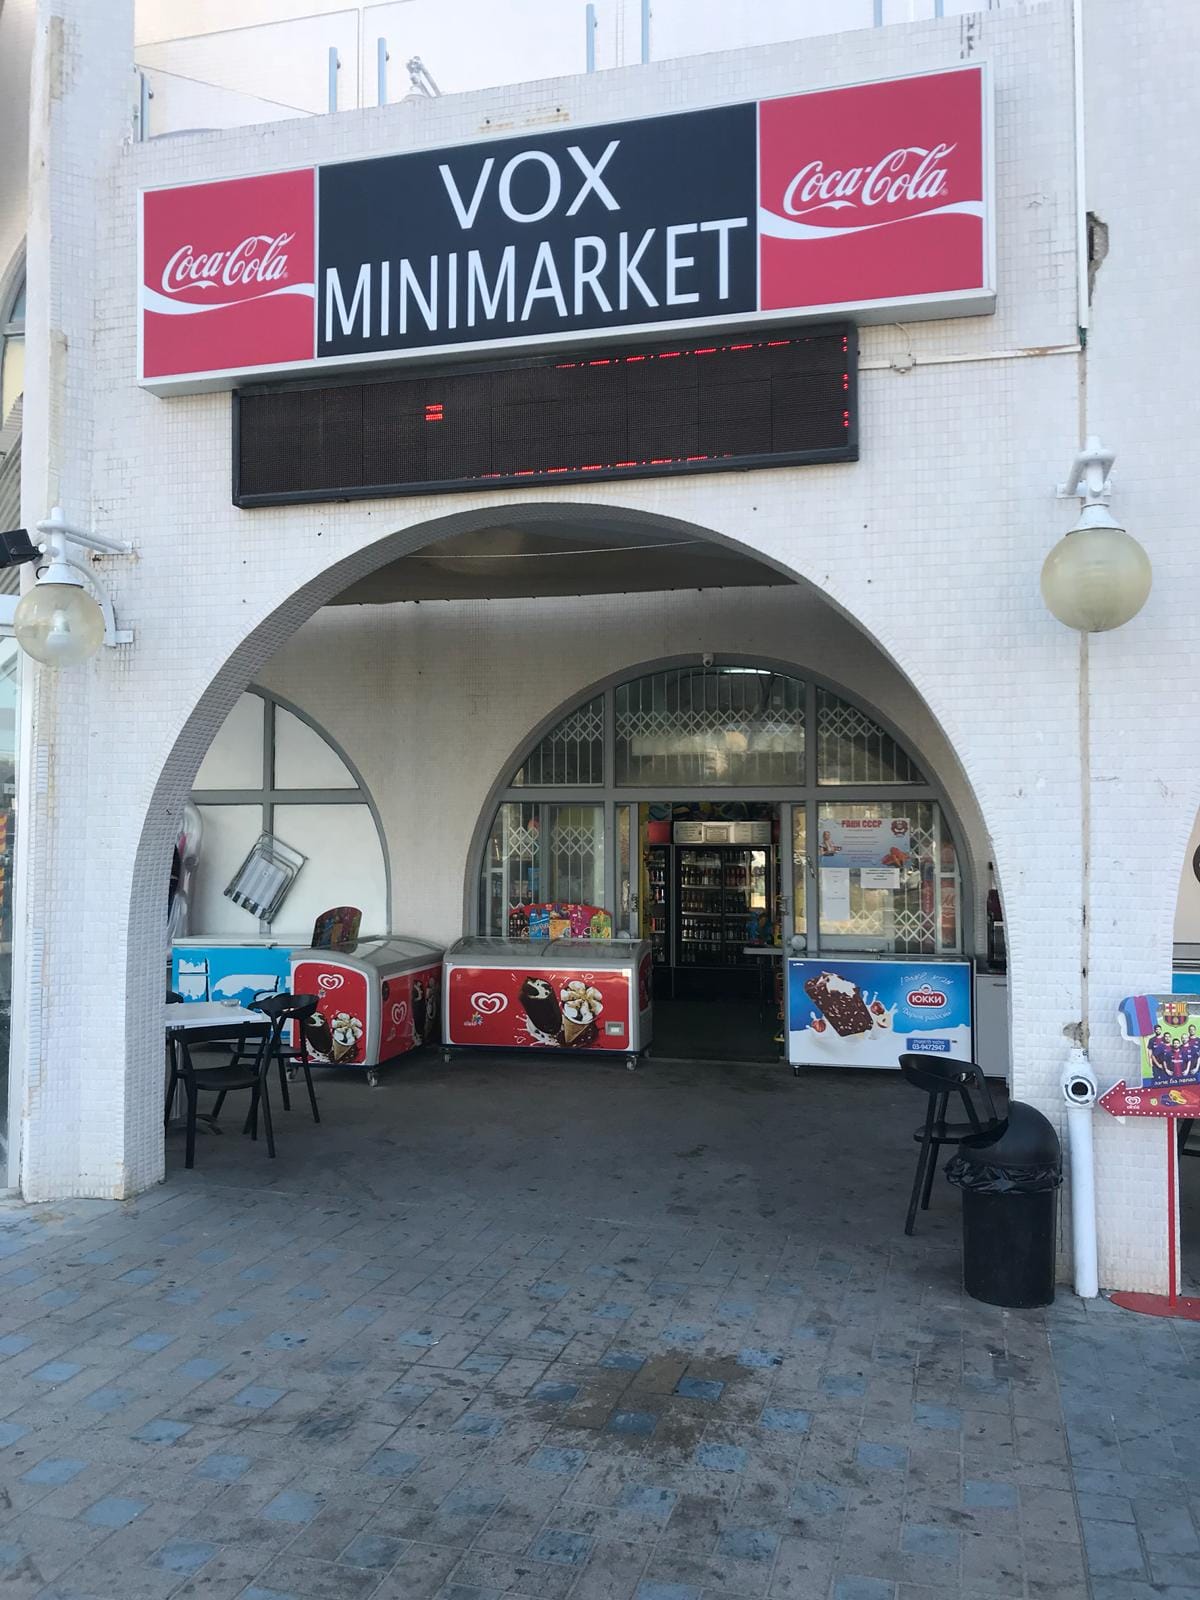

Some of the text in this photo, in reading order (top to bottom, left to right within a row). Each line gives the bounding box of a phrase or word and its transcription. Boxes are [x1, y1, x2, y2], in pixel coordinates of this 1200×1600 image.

[438, 140, 622, 230] VOX
[782, 142, 958, 216] Coca-Cola
[161, 232, 296, 292] Coca-Cola
[324, 217, 749, 343] MINIMARKET
[912, 995, 942, 1005] ЮККИ
